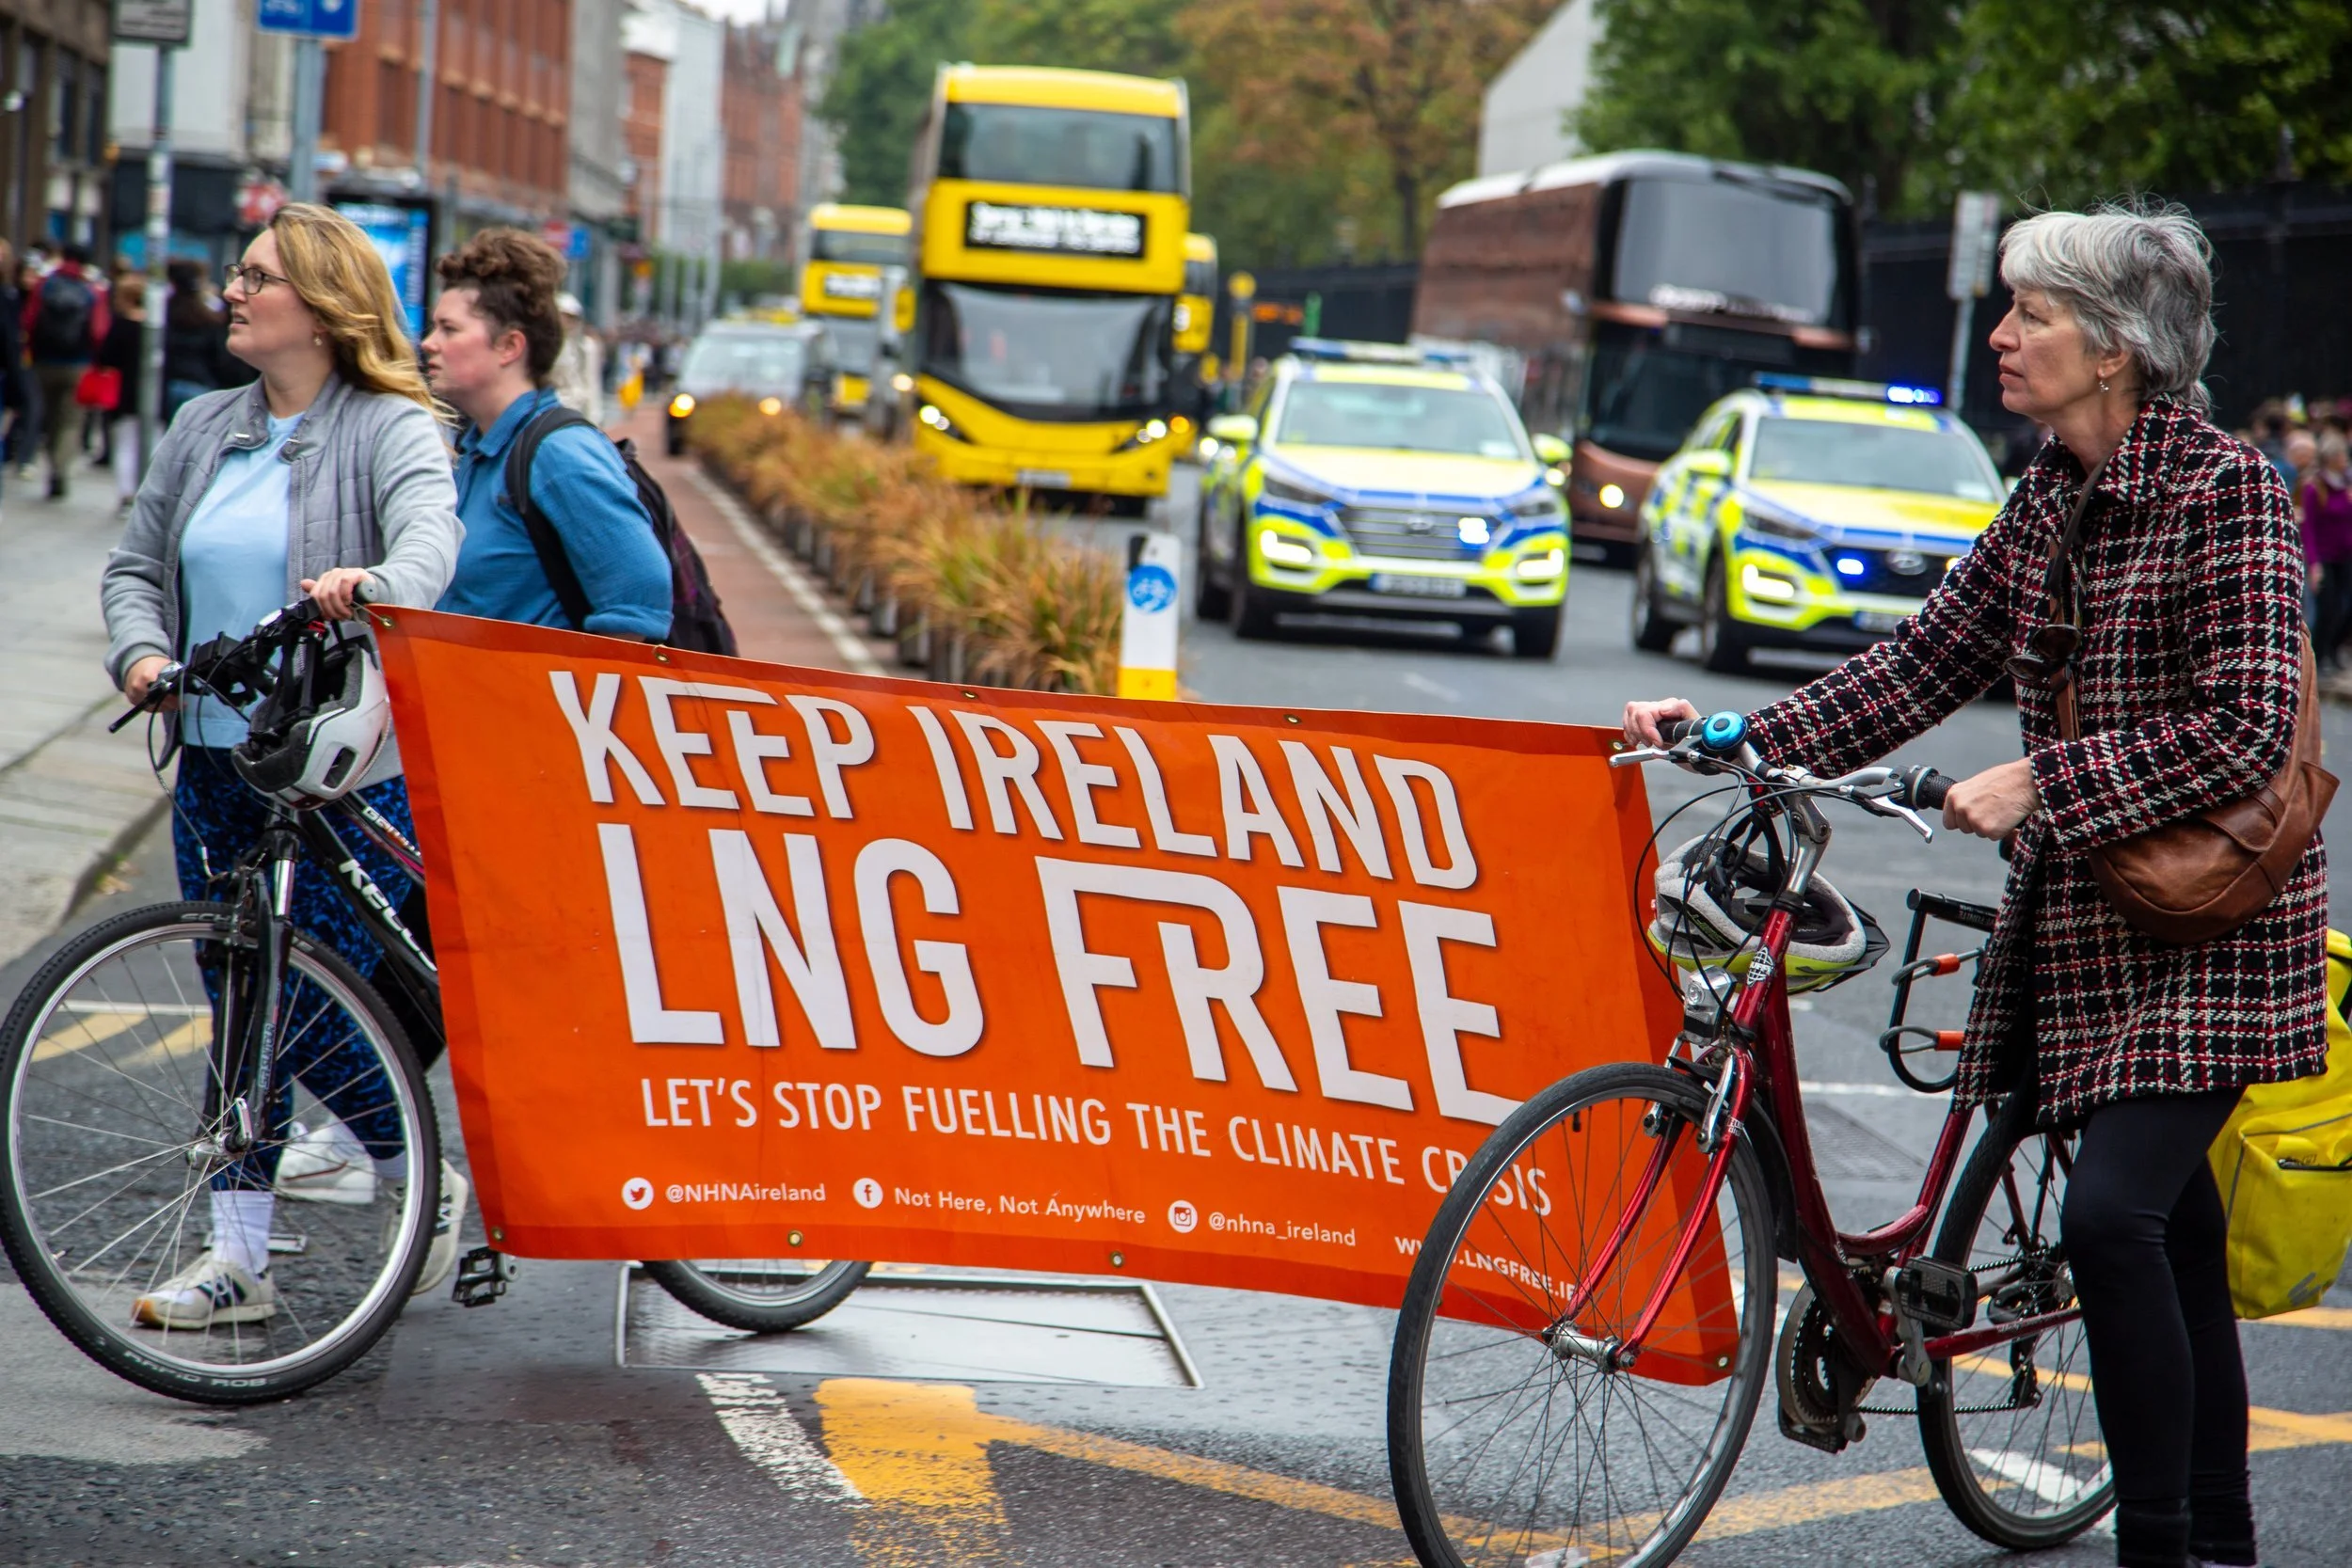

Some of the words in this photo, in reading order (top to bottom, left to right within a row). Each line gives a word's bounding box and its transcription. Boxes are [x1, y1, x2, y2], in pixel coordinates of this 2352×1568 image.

[549, 672, 875, 819] KEEP
[907, 706, 1477, 890] IRELAND
[597, 823, 984, 1057] LNG
[1035, 856, 1524, 1127] FREE
[643, 1078, 757, 1128] LET'S
[774, 1082, 882, 1131] STOP
[903, 1086, 1111, 1146] FUELLING
[1127, 1103, 1212, 1157] THE
[1230, 1117, 1405, 1185] CLIMATE
[1422, 1147, 1551, 1216] CRSIS
[666, 1183, 826, 1203] @NHNAireland
[895, 1187, 931, 1208] Not
[939, 1191, 992, 1213] Here,
[1000, 1195, 1039, 1215] Not
[1045, 1198, 1146, 1224] Anywhere
[1209, 1212, 1357, 1246] @nhna_ireland
